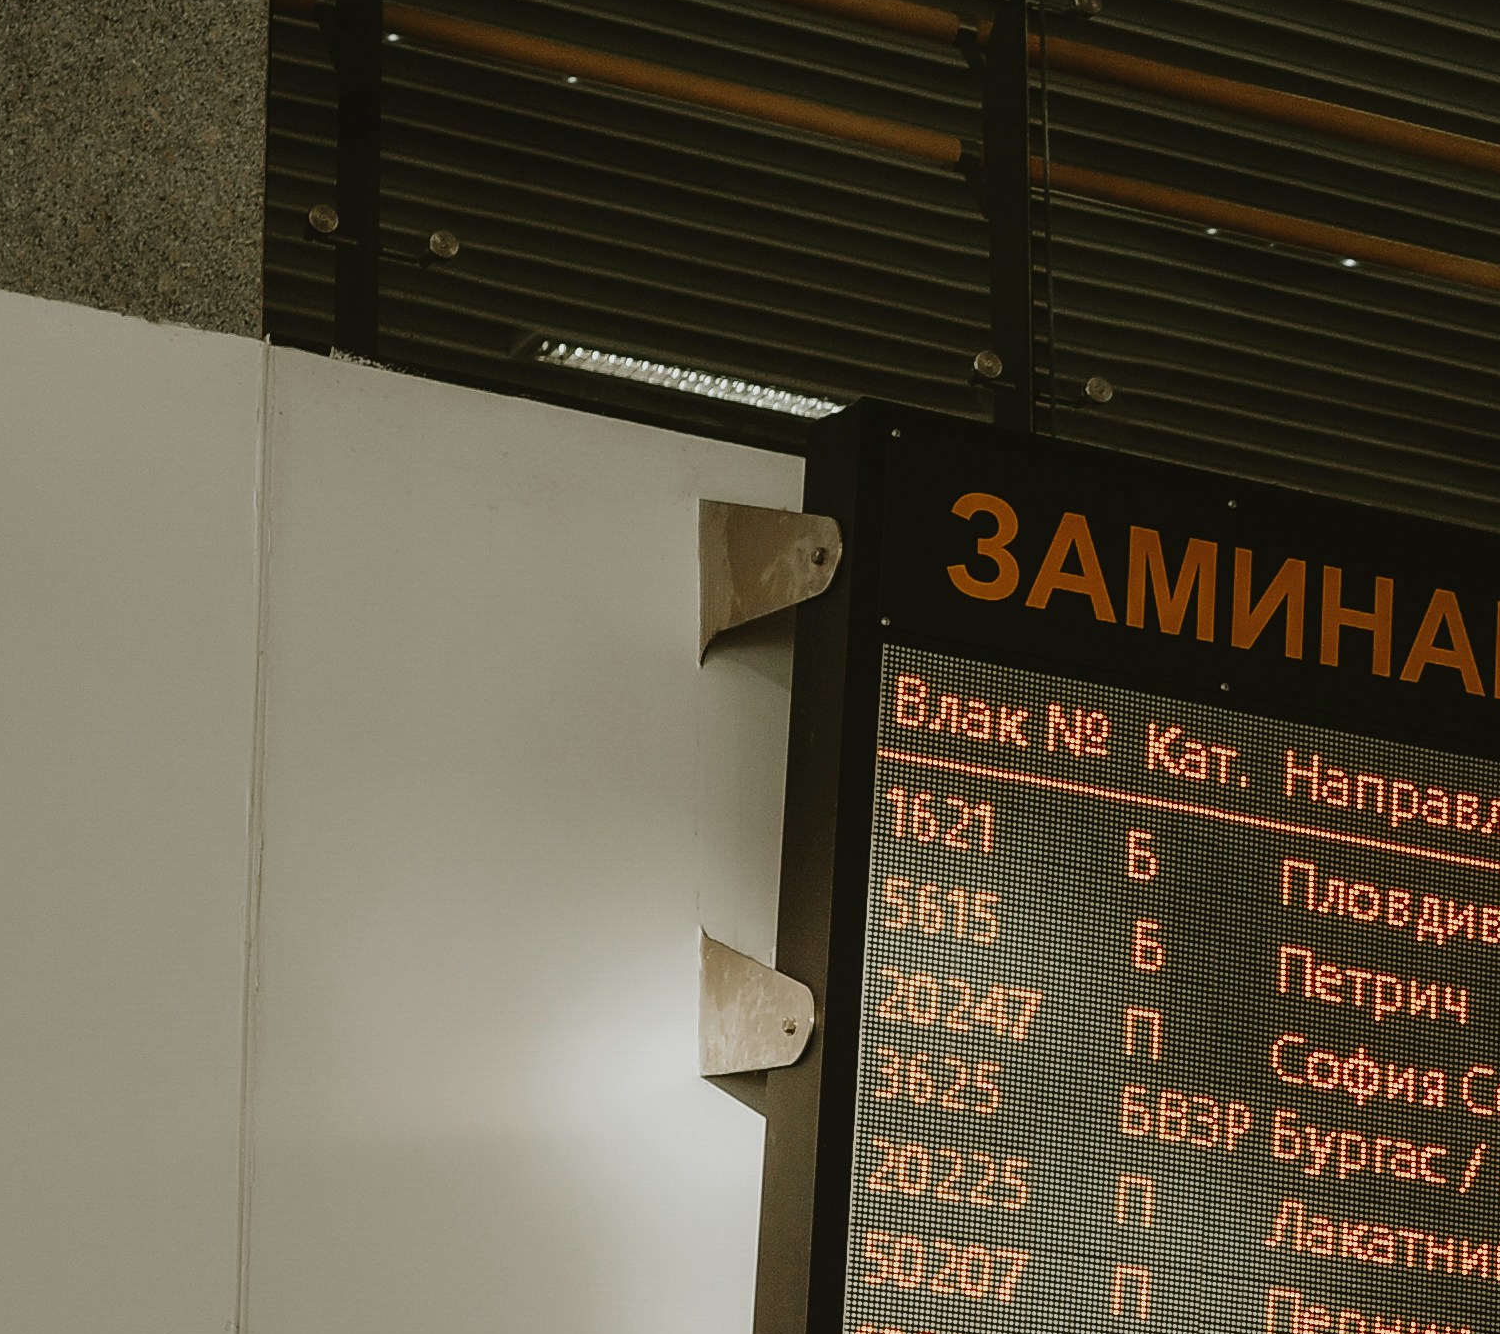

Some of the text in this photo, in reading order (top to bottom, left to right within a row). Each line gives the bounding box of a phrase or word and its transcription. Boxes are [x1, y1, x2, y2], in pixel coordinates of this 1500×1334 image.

[894, 672, 1031, 748] Влак
[1044, 703, 1112, 758] №
[1144, 722, 1251, 788] Кат.
[887, 787, 995, 853] 1621
[883, 878, 999, 940] 5615
[1276, 945, 1470, 1024] Петрич
[883, 969, 1043, 1040] 20247
[1268, 1034, 1448, 1107] София
[868, 1138, 1028, 1207] 20225
[876, 1048, 999, 1114] 3625
[1270, 1109, 1447, 1184] Бургас
[865, 1232, 1031, 1298] 50207
